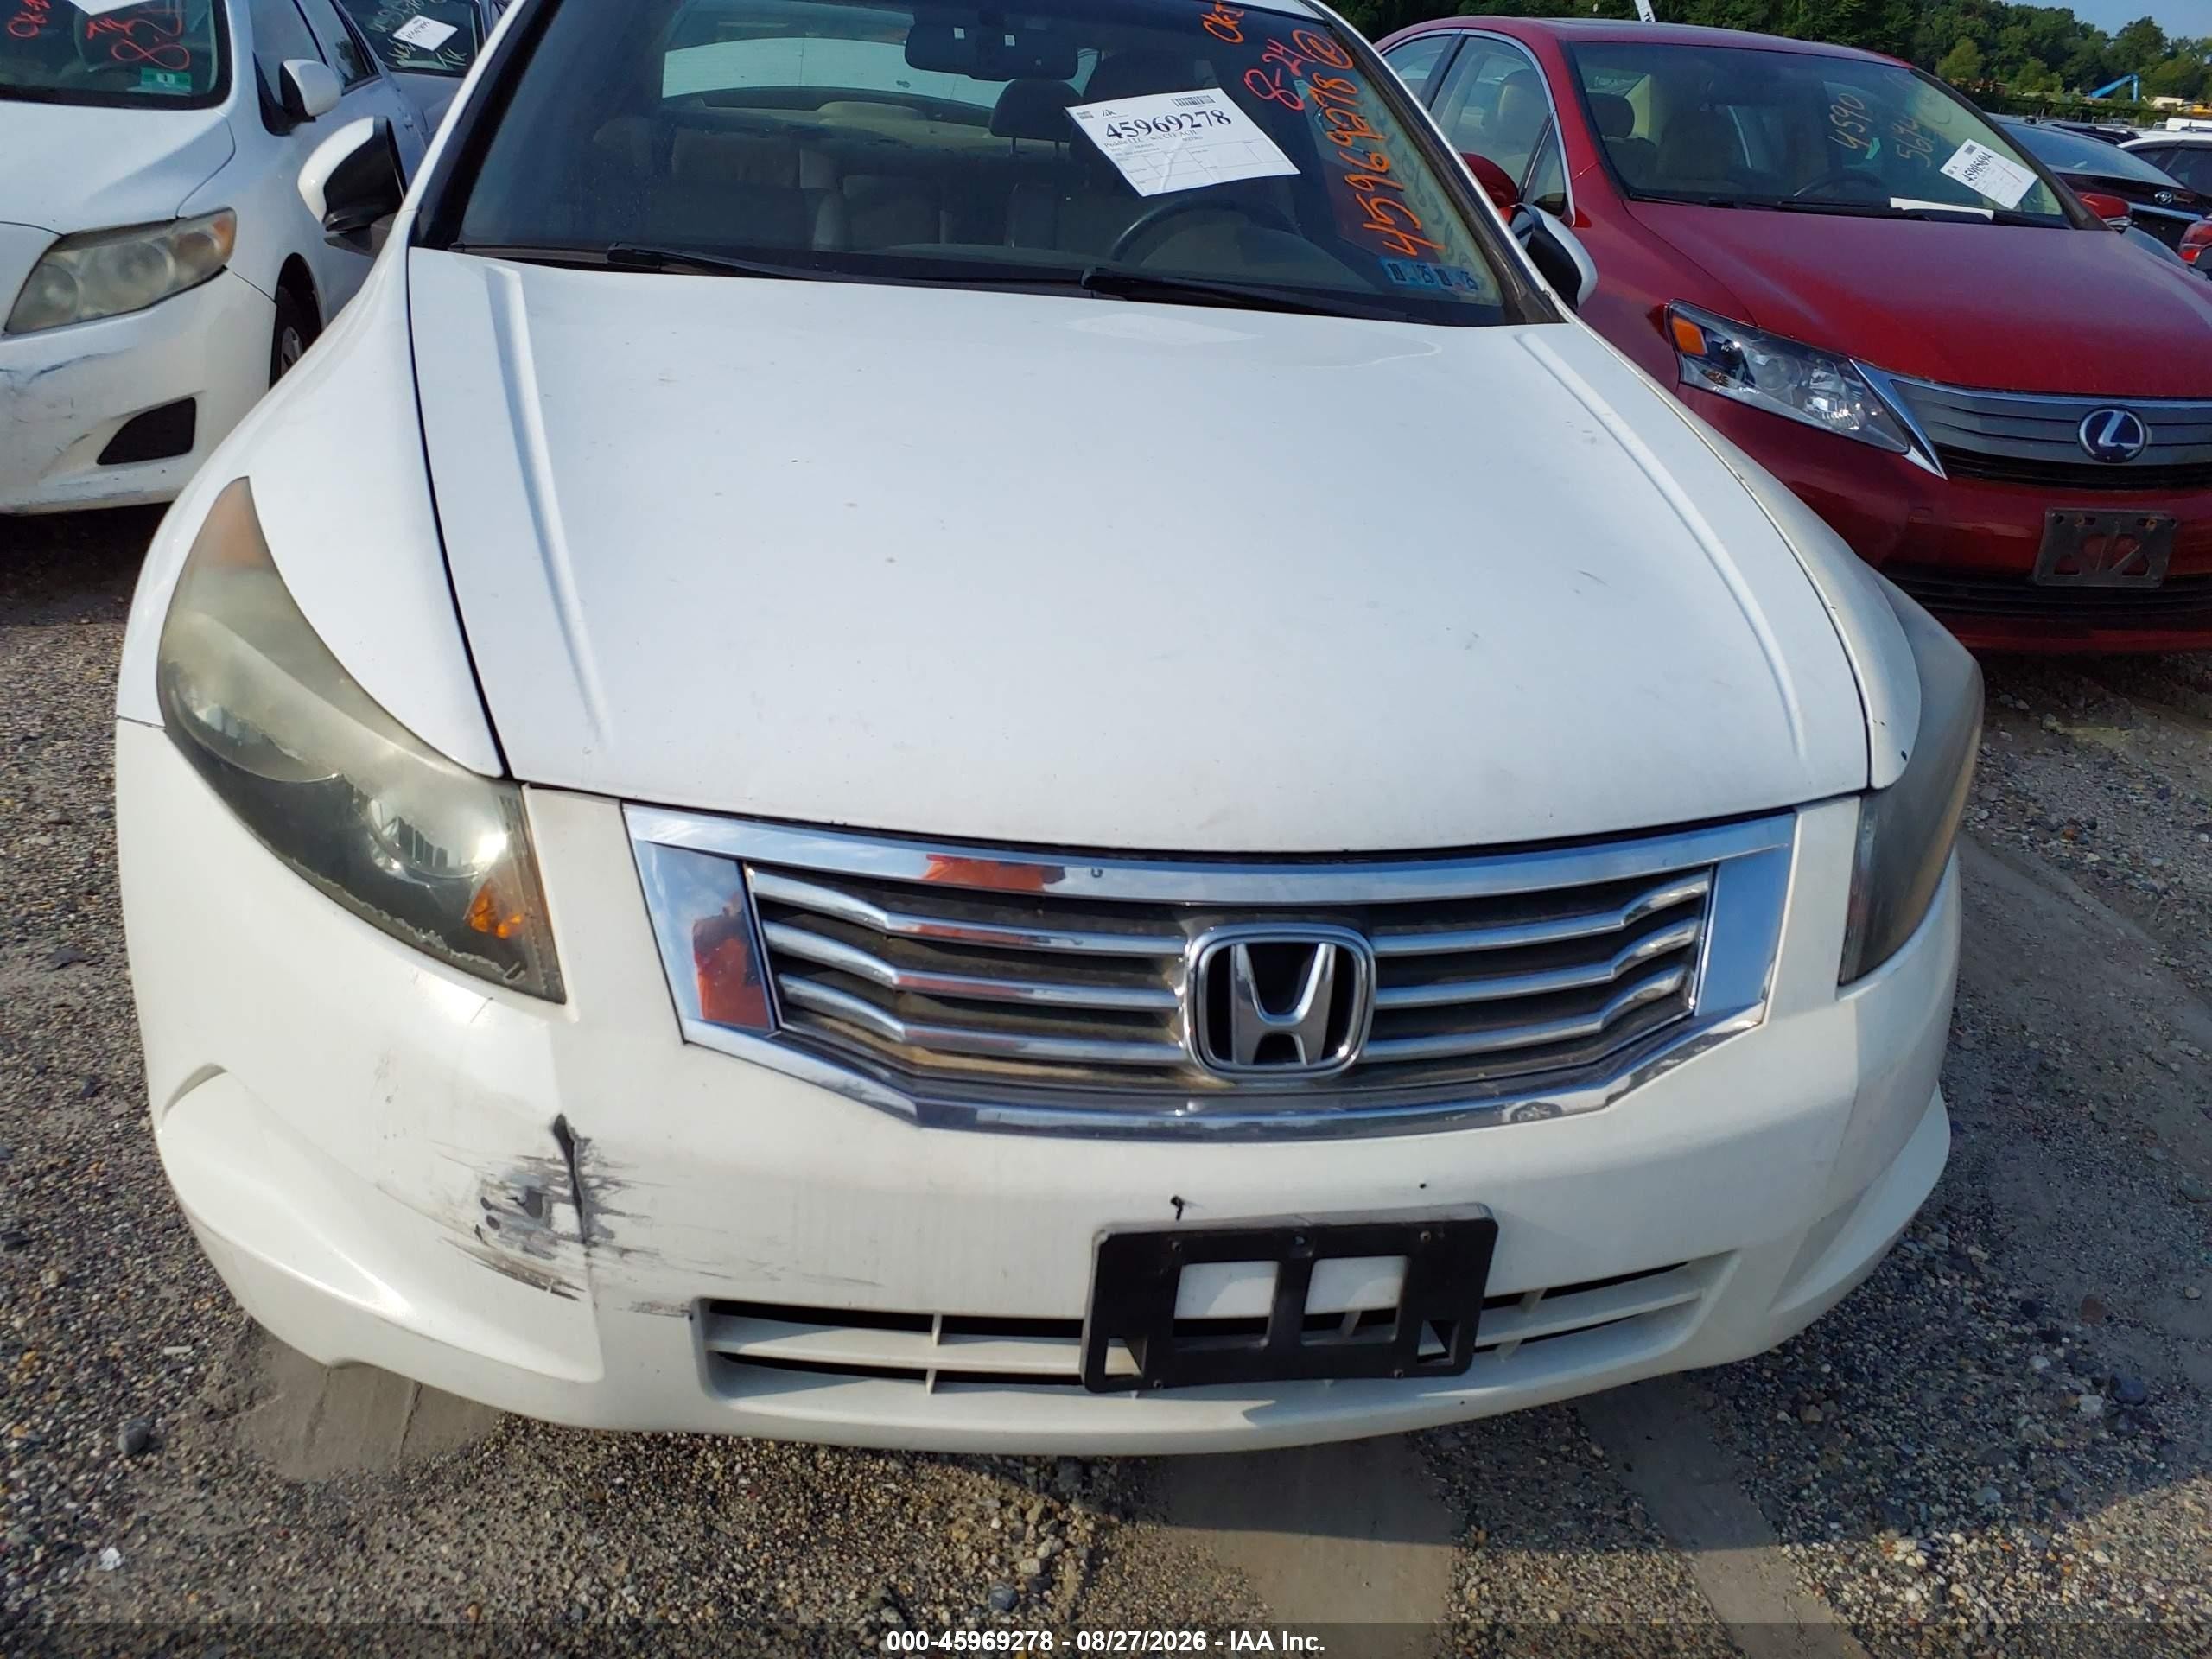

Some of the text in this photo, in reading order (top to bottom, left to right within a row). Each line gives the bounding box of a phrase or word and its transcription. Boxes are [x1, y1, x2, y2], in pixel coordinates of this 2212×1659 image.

[1106, 110, 1231, 138] 45969278
[1827, 92, 1873, 149] 4590
[1308, 73, 1446, 256] 45969278
